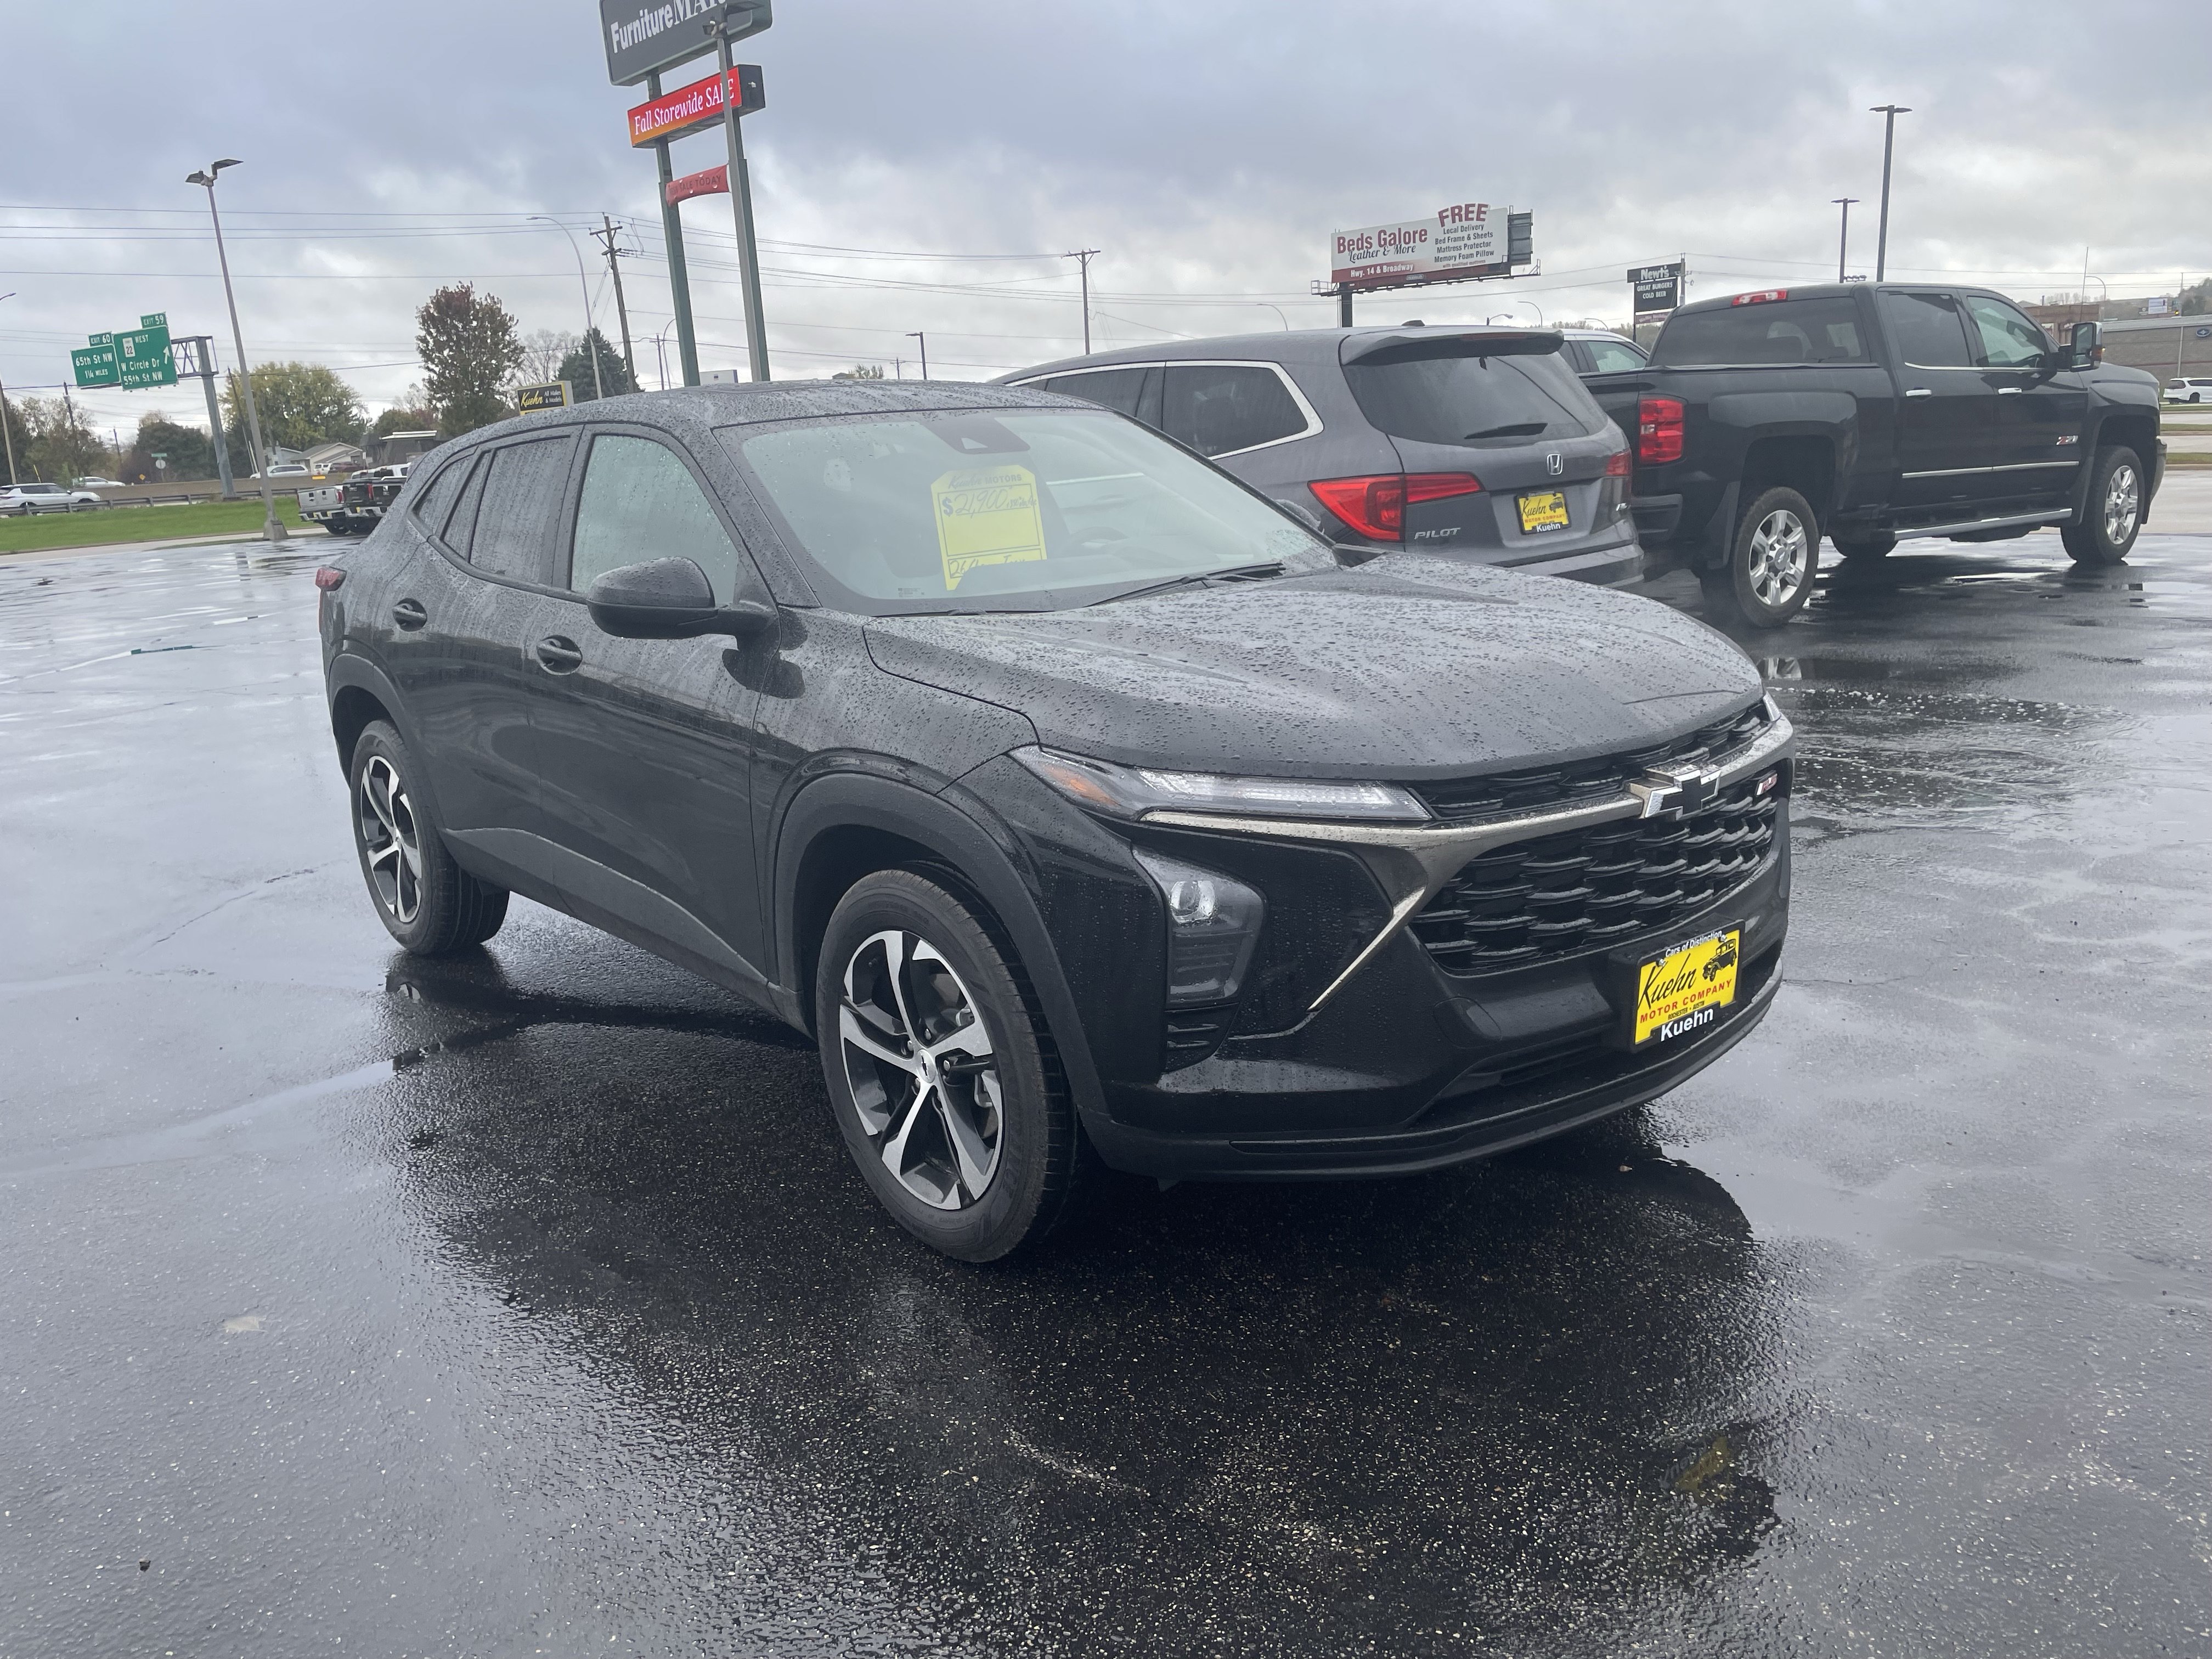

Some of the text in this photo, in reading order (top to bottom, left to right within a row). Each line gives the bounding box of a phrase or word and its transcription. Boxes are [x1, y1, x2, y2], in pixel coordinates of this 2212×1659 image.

[634, 110, 652, 135] Fall
[654, 92, 703, 127] Storewide
[695, 175, 721, 187] TODAY
[1438, 203, 1489, 228] FREE
[1443, 224, 1484, 235] Local Delivery
[1473, 231, 1493, 240] Sheets
[1337, 228, 1427, 254] Beds Galore
[1437, 241, 1491, 253] Mattress Protector
[1348, 244, 1416, 263] Leather & More
[1434, 255, 1457, 263] Memory
[1351, 269, 1365, 278] Hwy.
[1383, 263, 1414, 273] Broadway
[1640, 265, 1669, 280] Newt's
[1652, 281, 1673, 290] BURGERS
[143, 315, 163, 326] EXIT 59
[102, 334, 110, 343] 60
[134, 334, 149, 343] WEST
[126, 346, 133, 354] 22
[76, 353, 112, 367] 65th St NW
[121, 358, 160, 371] W Circle Dr
[123, 371, 163, 385] 55th St NW
[521, 390, 543, 408] Kuehn
[985, 474, 1022, 484] MOTORS
[1522, 499, 1546, 518] Kuehn
[1414, 527, 1461, 539] PILOT
[1537, 523, 1561, 532] Kuehn
[1666, 930, 1722, 957] Cars of Distinction
[1637, 953, 1696, 1011] Kuehn
[1640, 979, 1732, 1023] MOTOR COMPANY
[1661, 1008, 1713, 1042] Kuehn
